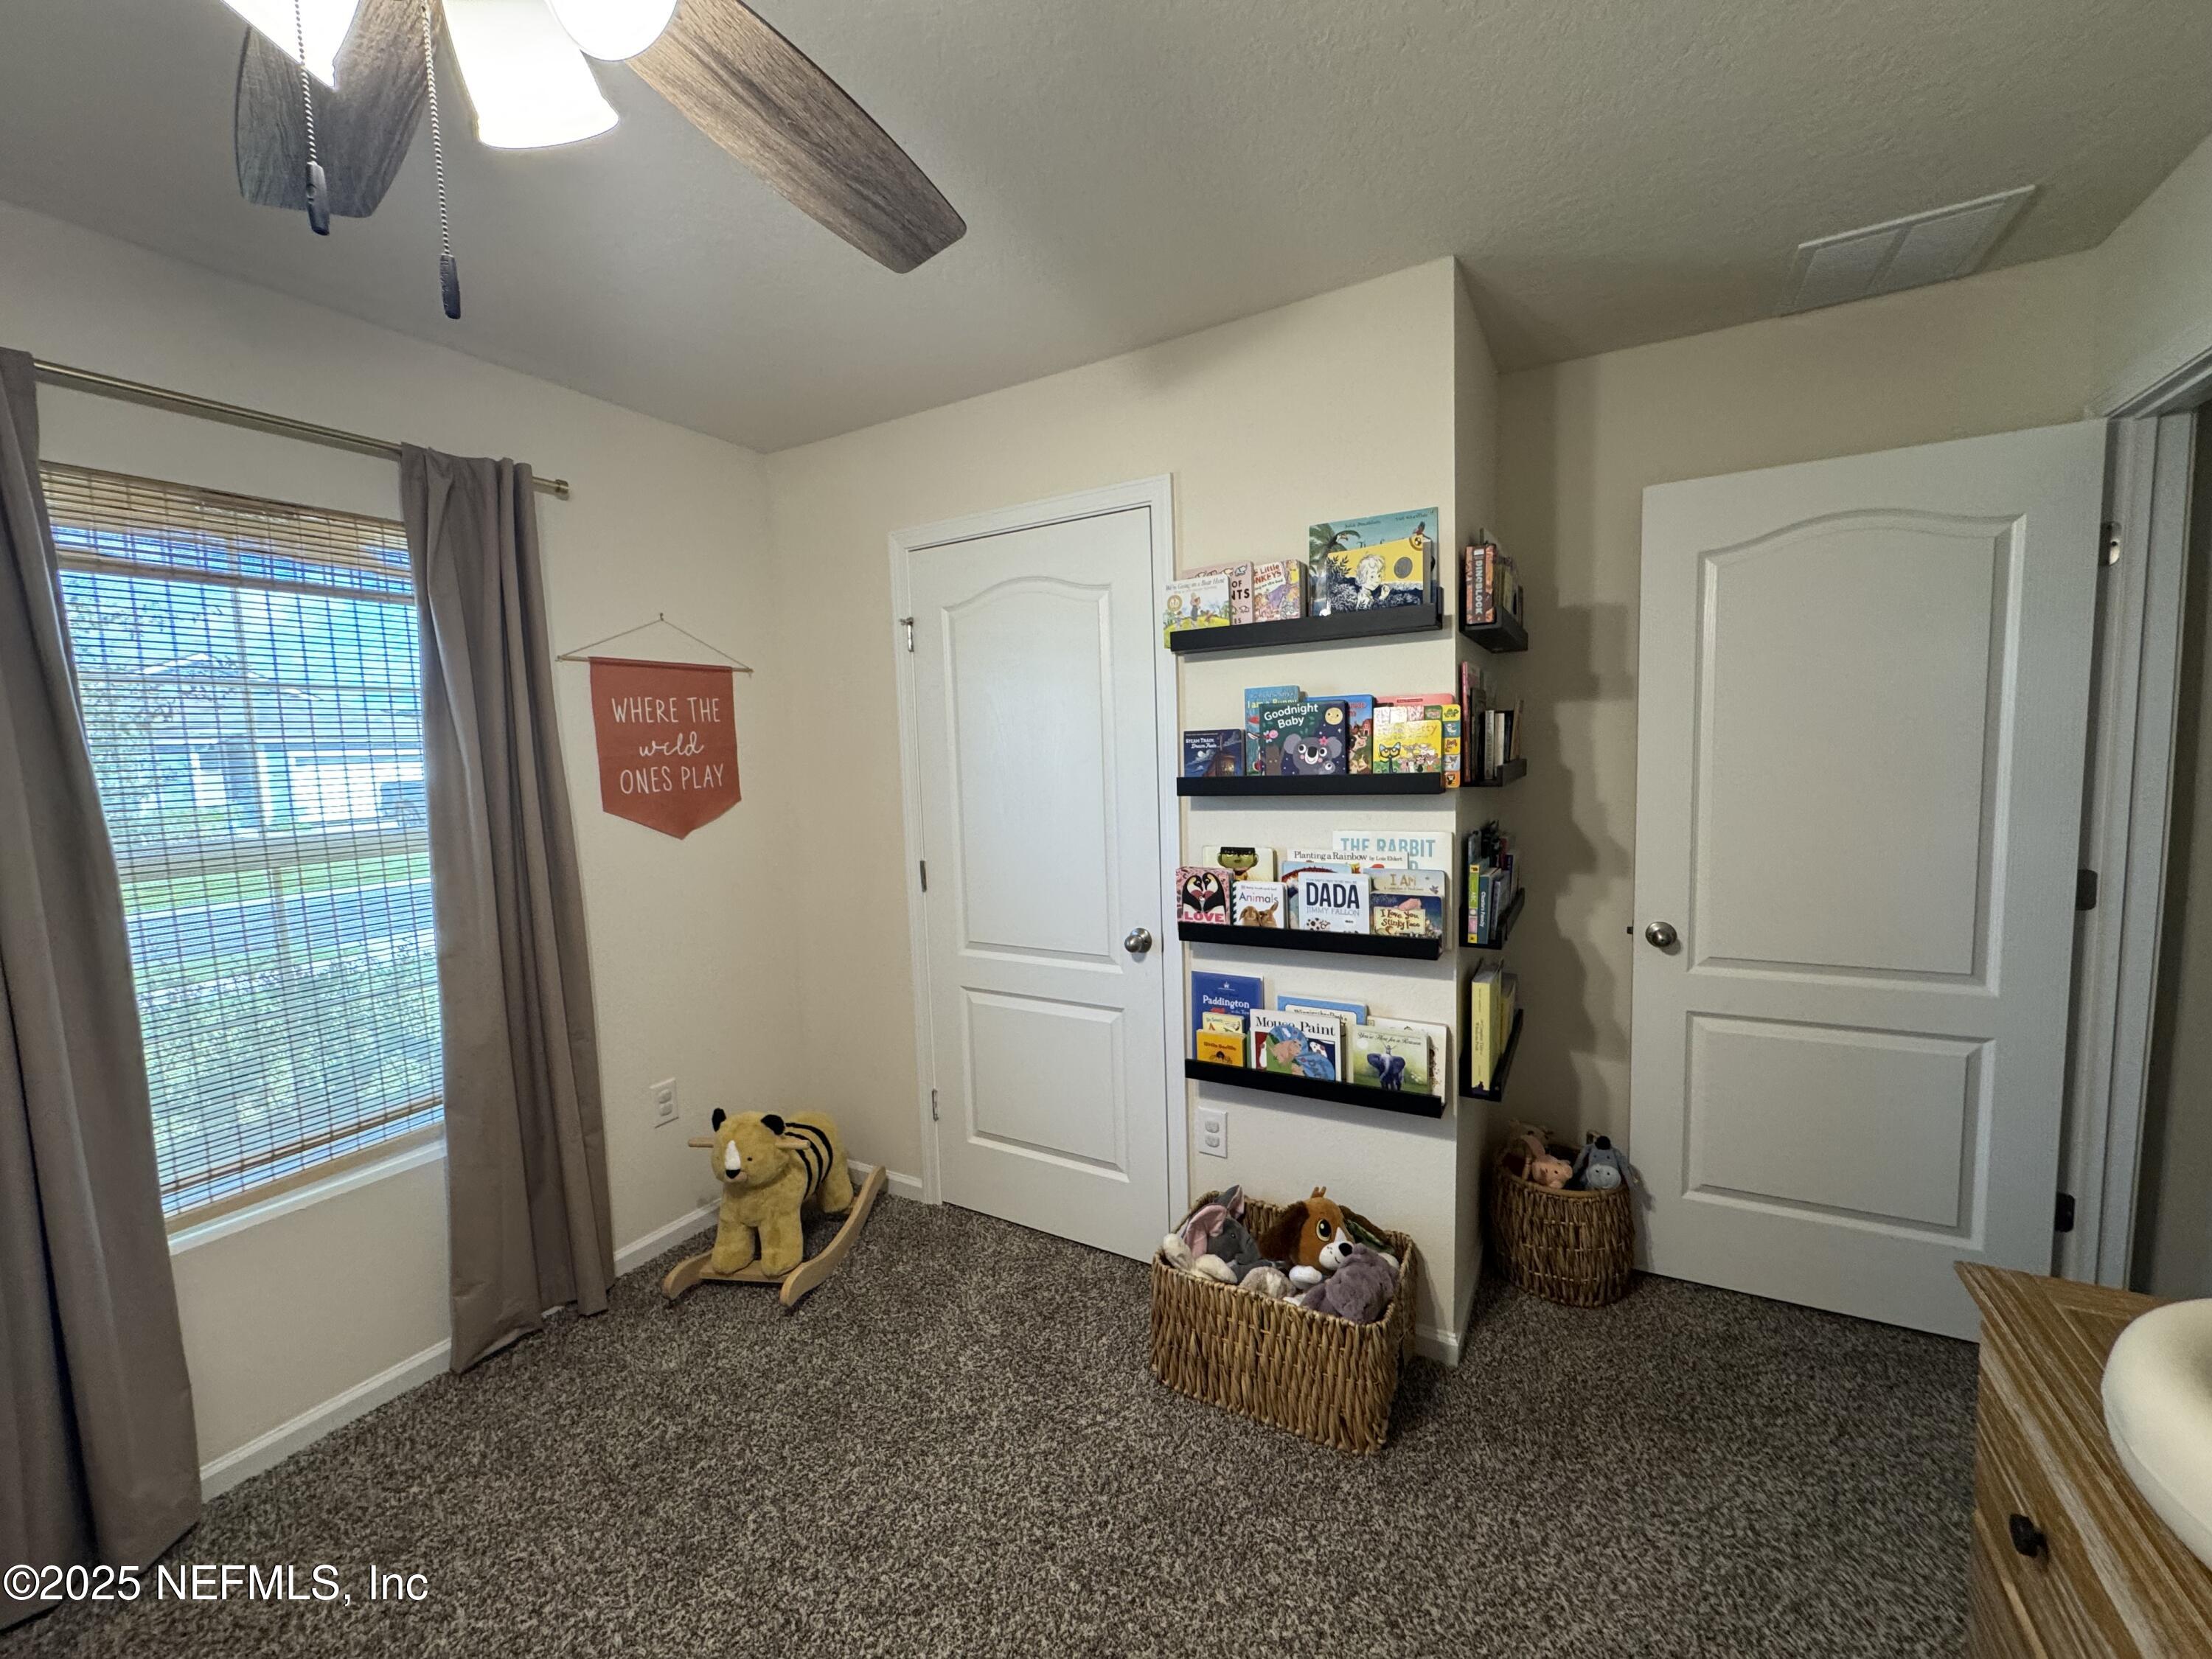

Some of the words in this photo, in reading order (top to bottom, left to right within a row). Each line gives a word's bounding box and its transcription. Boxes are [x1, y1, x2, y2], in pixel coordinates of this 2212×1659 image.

[1260, 563, 1280, 574] Little
[1253, 571, 1282, 585] NKEYS
[611, 697, 679, 723] WHERE
[687, 697, 720, 723] THE
[1264, 703, 1318, 721] Goodnight
[1277, 717, 1304, 729] Baby
[639, 731, 704, 757] wild
[619, 765, 672, 794] ONES
[681, 763, 724, 790] PLAY
[1340, 838, 1371, 852] THE
[1377, 838, 1436, 858] RABBIT
[1294, 850, 1326, 861] Planting
[1332, 852, 1368, 861] Rainbow
[1239, 891, 1279, 903] Animals
[1306, 882, 1360, 909] DADA
[1183, 911, 1225, 922] LOVE
[1306, 906, 1329, 915] JIMMY
[1330, 908, 1360, 917] FALLON
[1203, 995, 1250, 1009] Paddington
[1301, 1020, 1336, 1037] Paint
